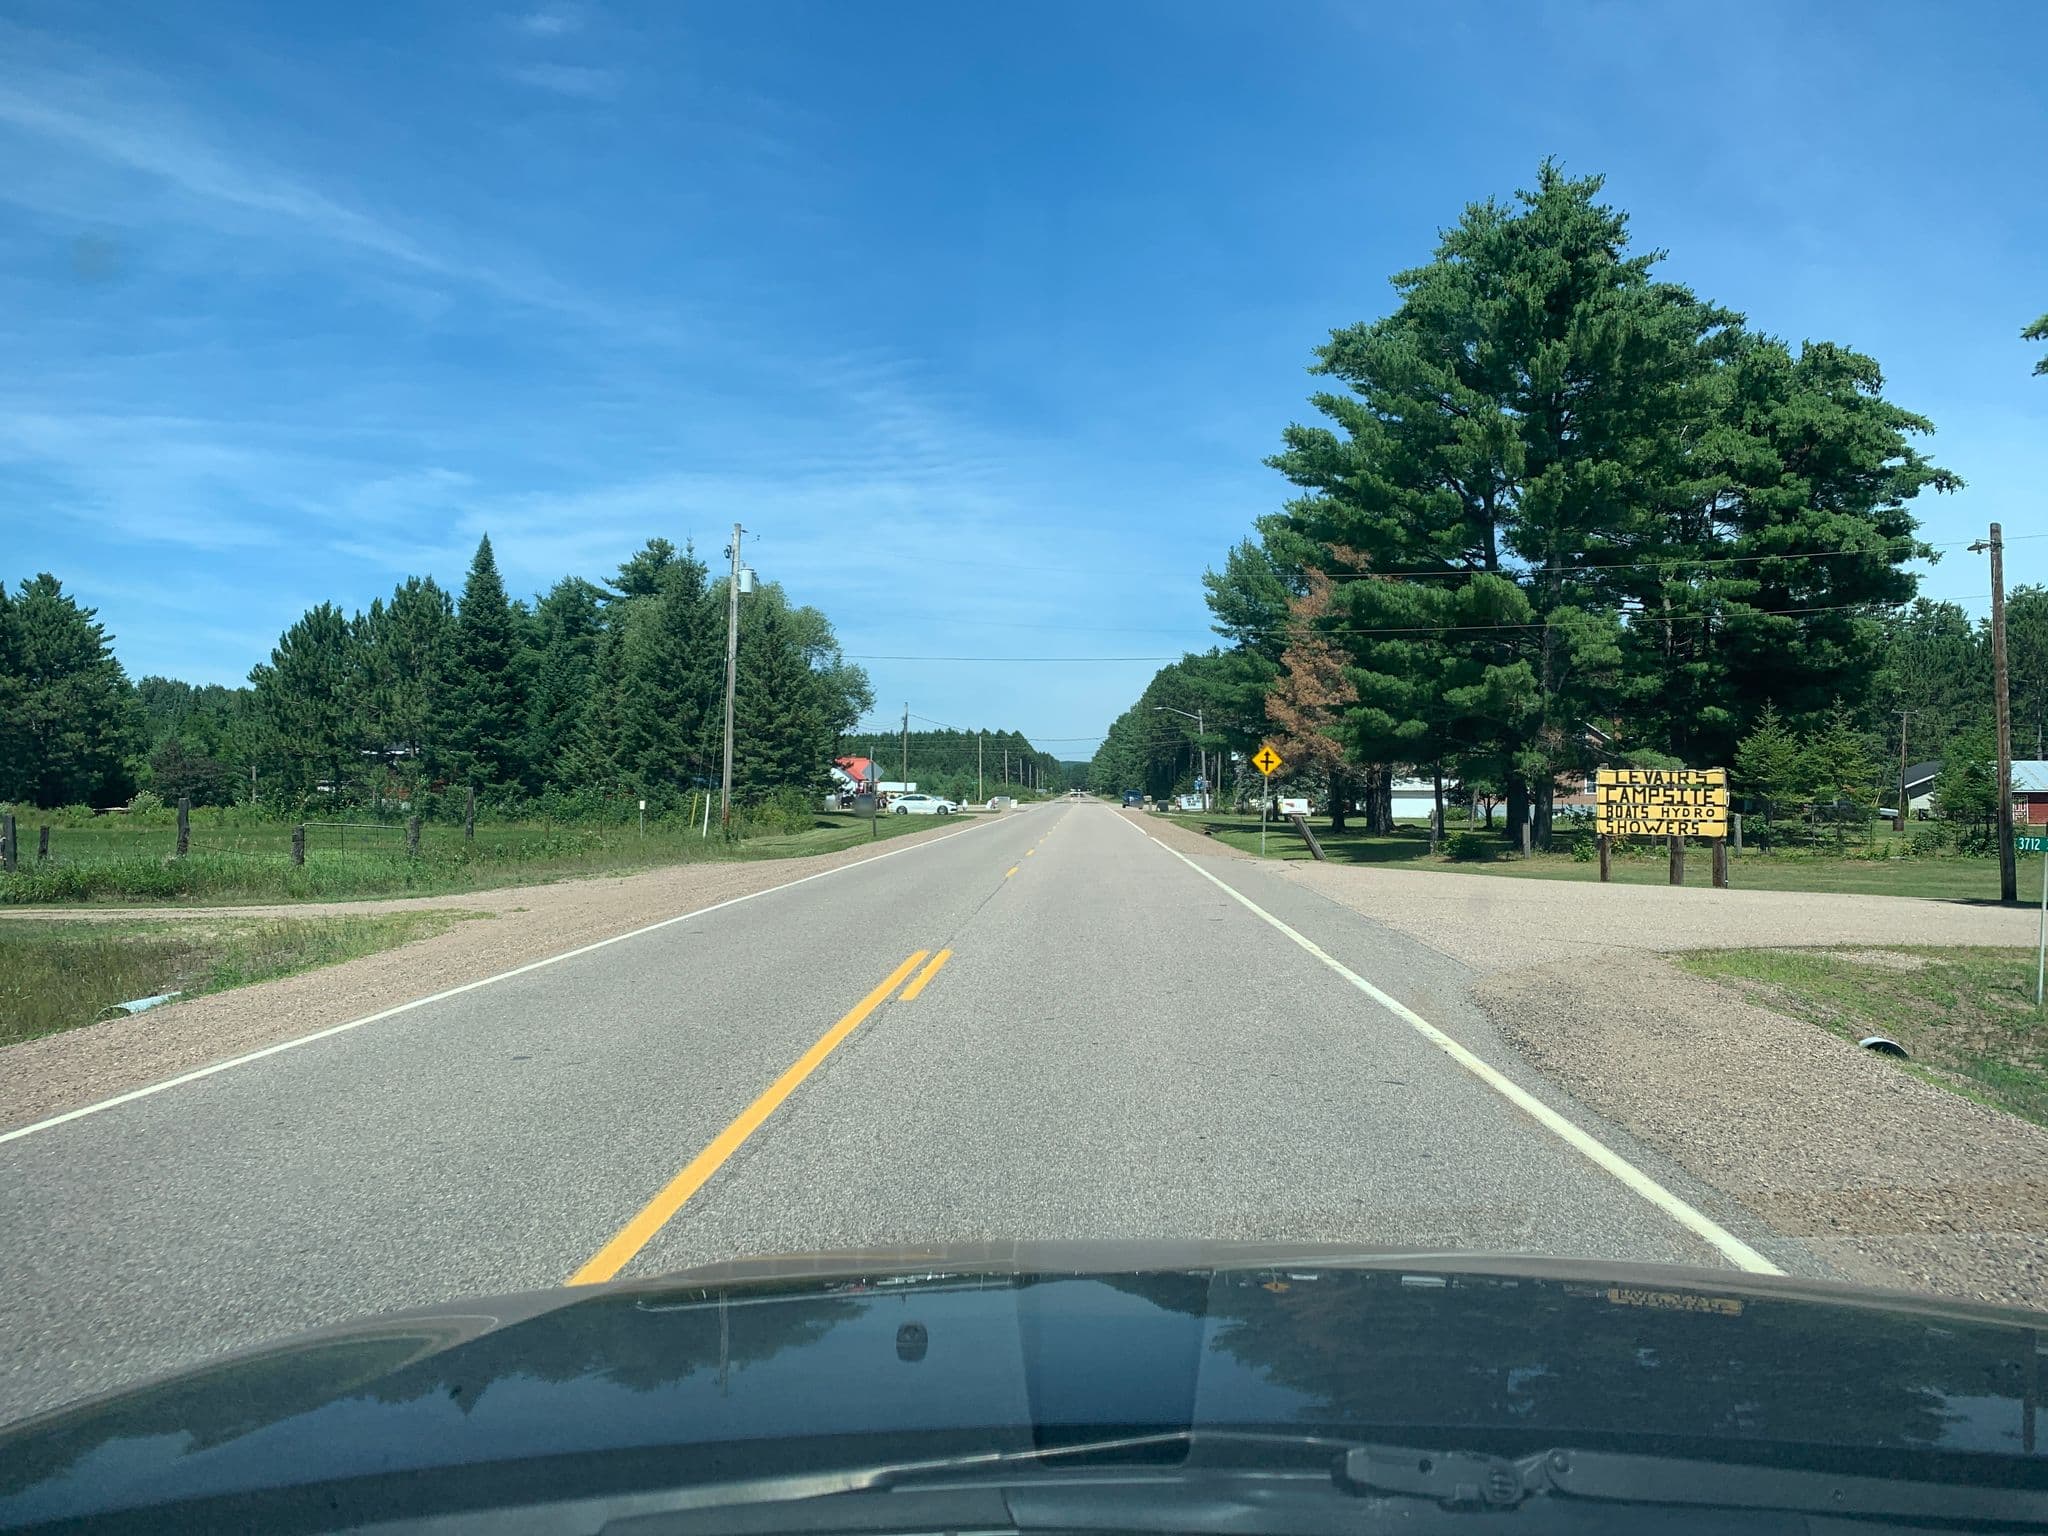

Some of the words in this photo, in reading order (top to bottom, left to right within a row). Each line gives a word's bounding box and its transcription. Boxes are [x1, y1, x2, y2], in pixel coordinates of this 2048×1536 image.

[1606, 786, 1715, 806] CAMPSITE
[1606, 805, 1649, 819] BOATS
[1661, 807, 1715, 818] HYDRO
[1606, 820, 1700, 835] SHOWERS
[2018, 837, 2041, 851] 3712
